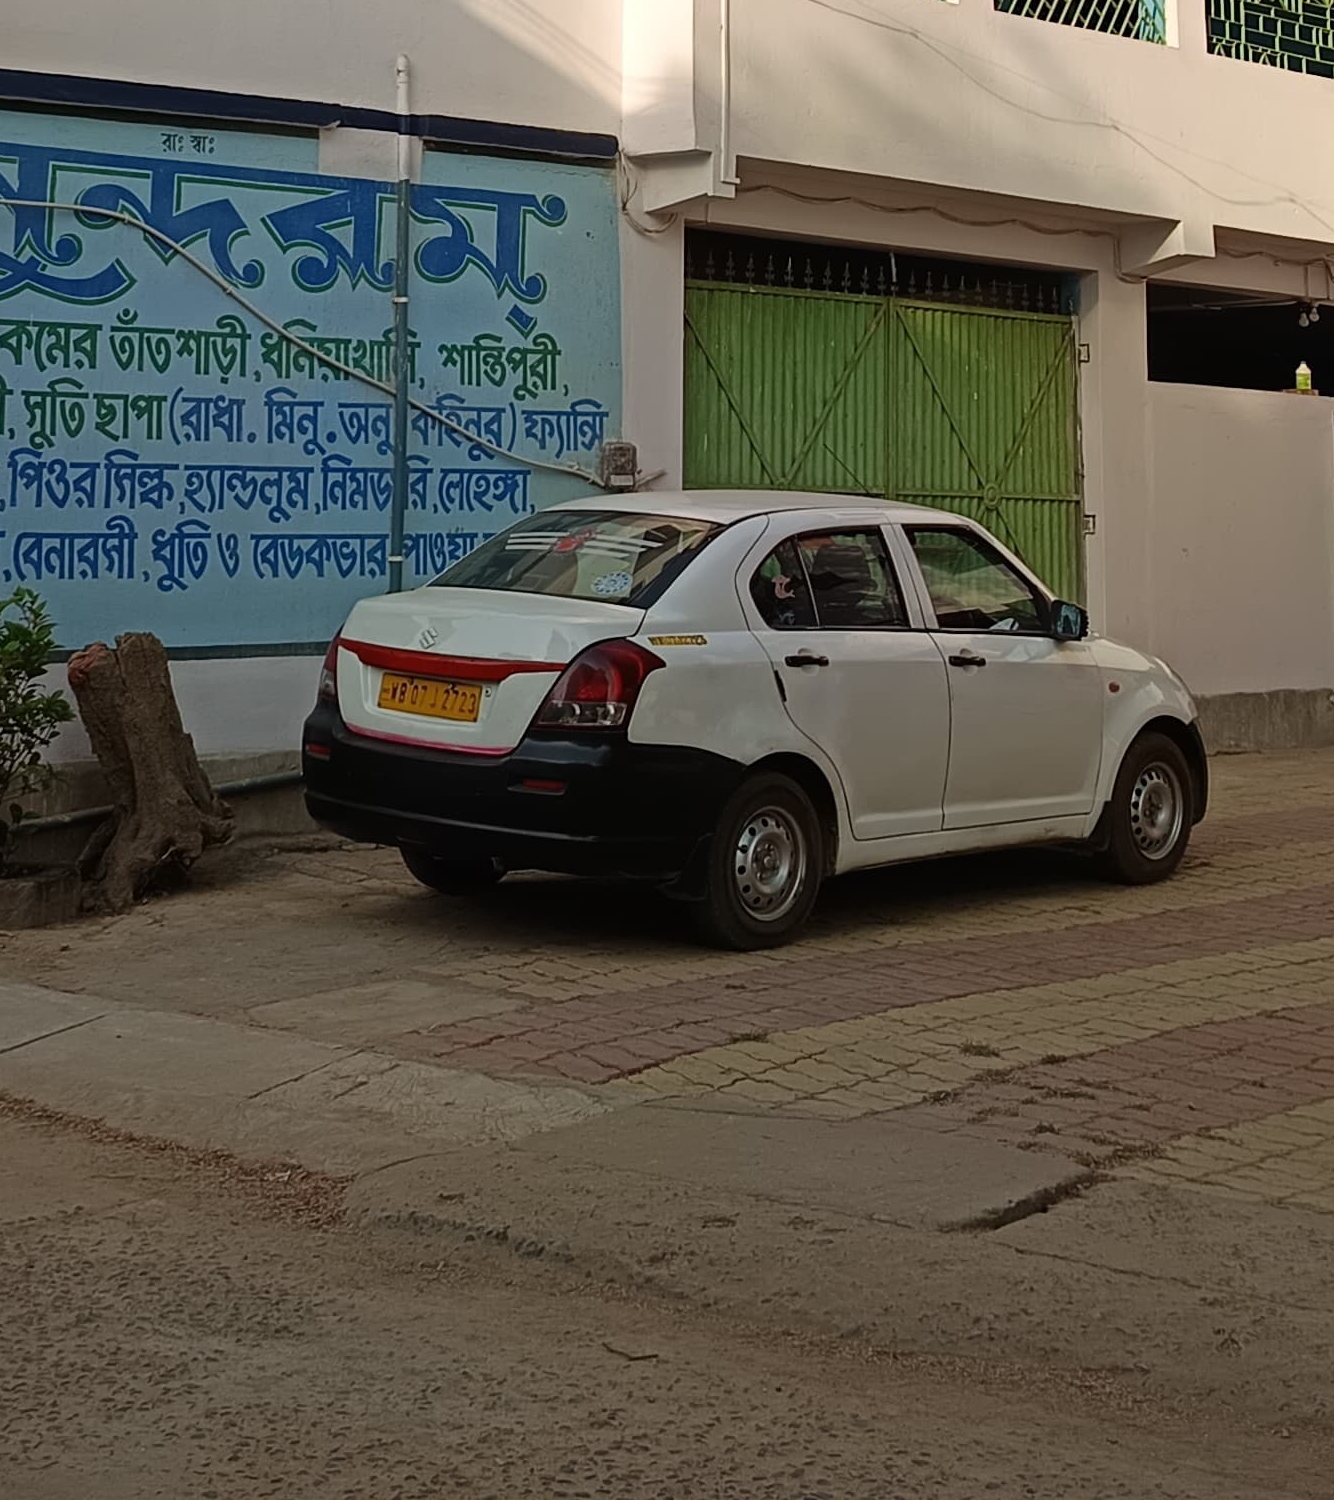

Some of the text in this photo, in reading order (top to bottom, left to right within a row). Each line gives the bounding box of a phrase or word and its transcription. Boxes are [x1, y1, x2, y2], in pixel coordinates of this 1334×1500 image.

[151, 518, 212, 592] ধুতি
[217, 532, 240, 578] ও
[441, 688, 477, 714] 2723
